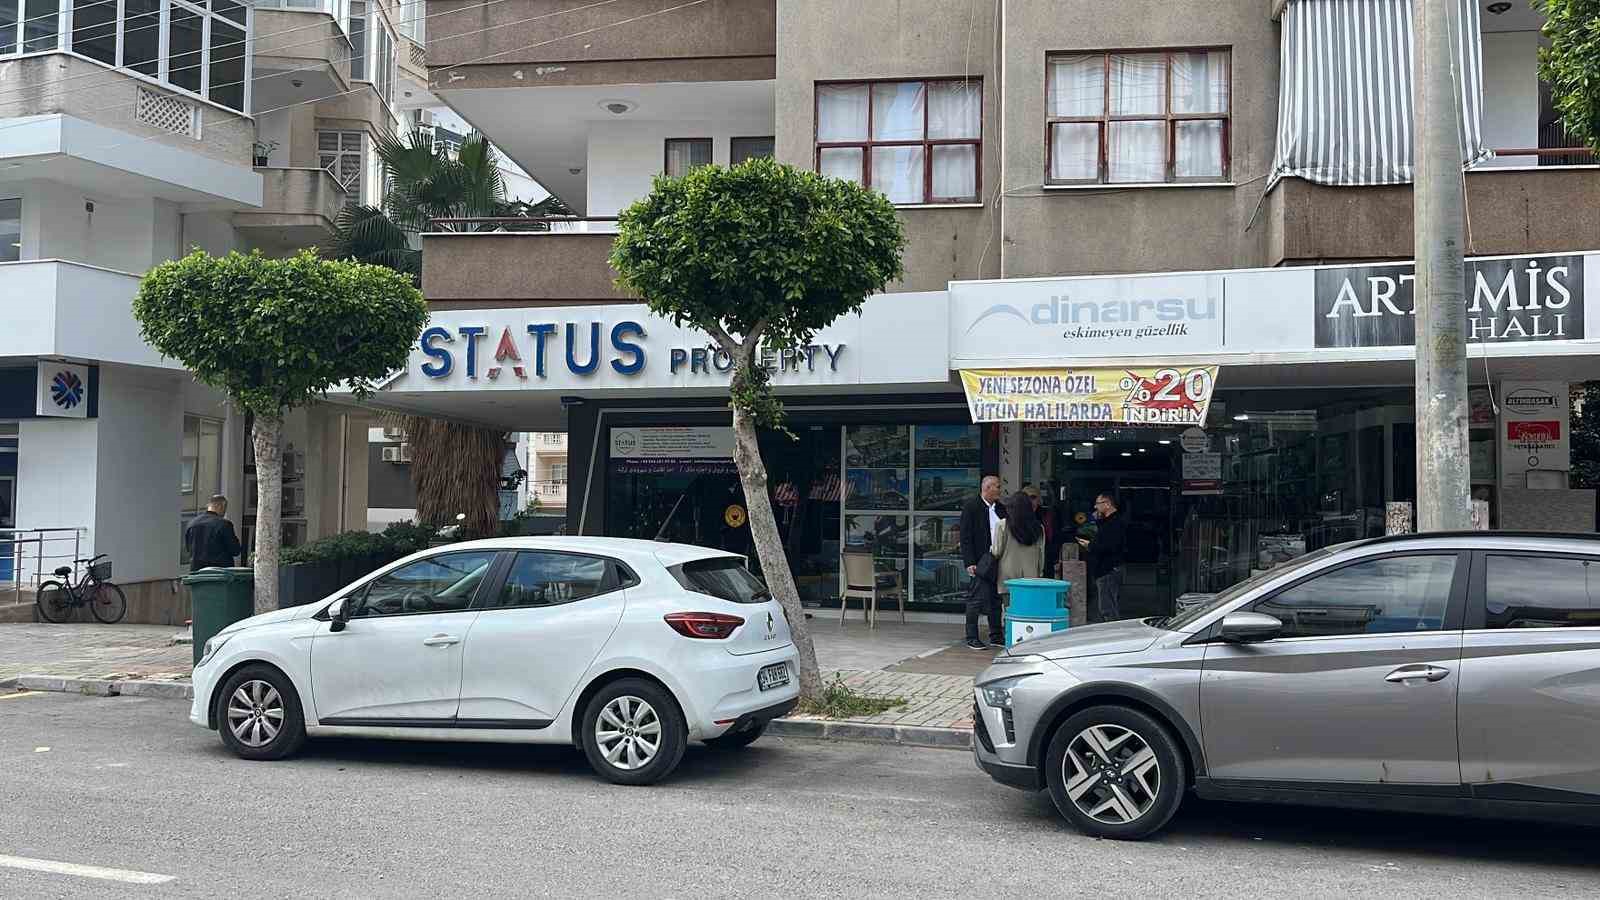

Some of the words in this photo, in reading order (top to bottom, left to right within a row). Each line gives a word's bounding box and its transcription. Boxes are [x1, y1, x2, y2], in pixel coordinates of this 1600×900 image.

[1326, 260, 1571, 318] ARTMİS
[1031, 295, 1216, 325] dinarsu
[1063, 325, 1133, 339] eskimeyen
[1136, 322, 1189, 339] güzellik
[1468, 313, 1566, 339] HALI
[420, 320, 648, 380] STATUS
[670, 343, 847, 374] PROERTY
[979, 371, 1007, 395] YENİ
[1010, 375, 1061, 394] SEZONA
[1065, 369, 1097, 394] ÖZEL
[1119, 367, 1212, 403] %20
[1023, 402, 1113, 421] HALILARDA
